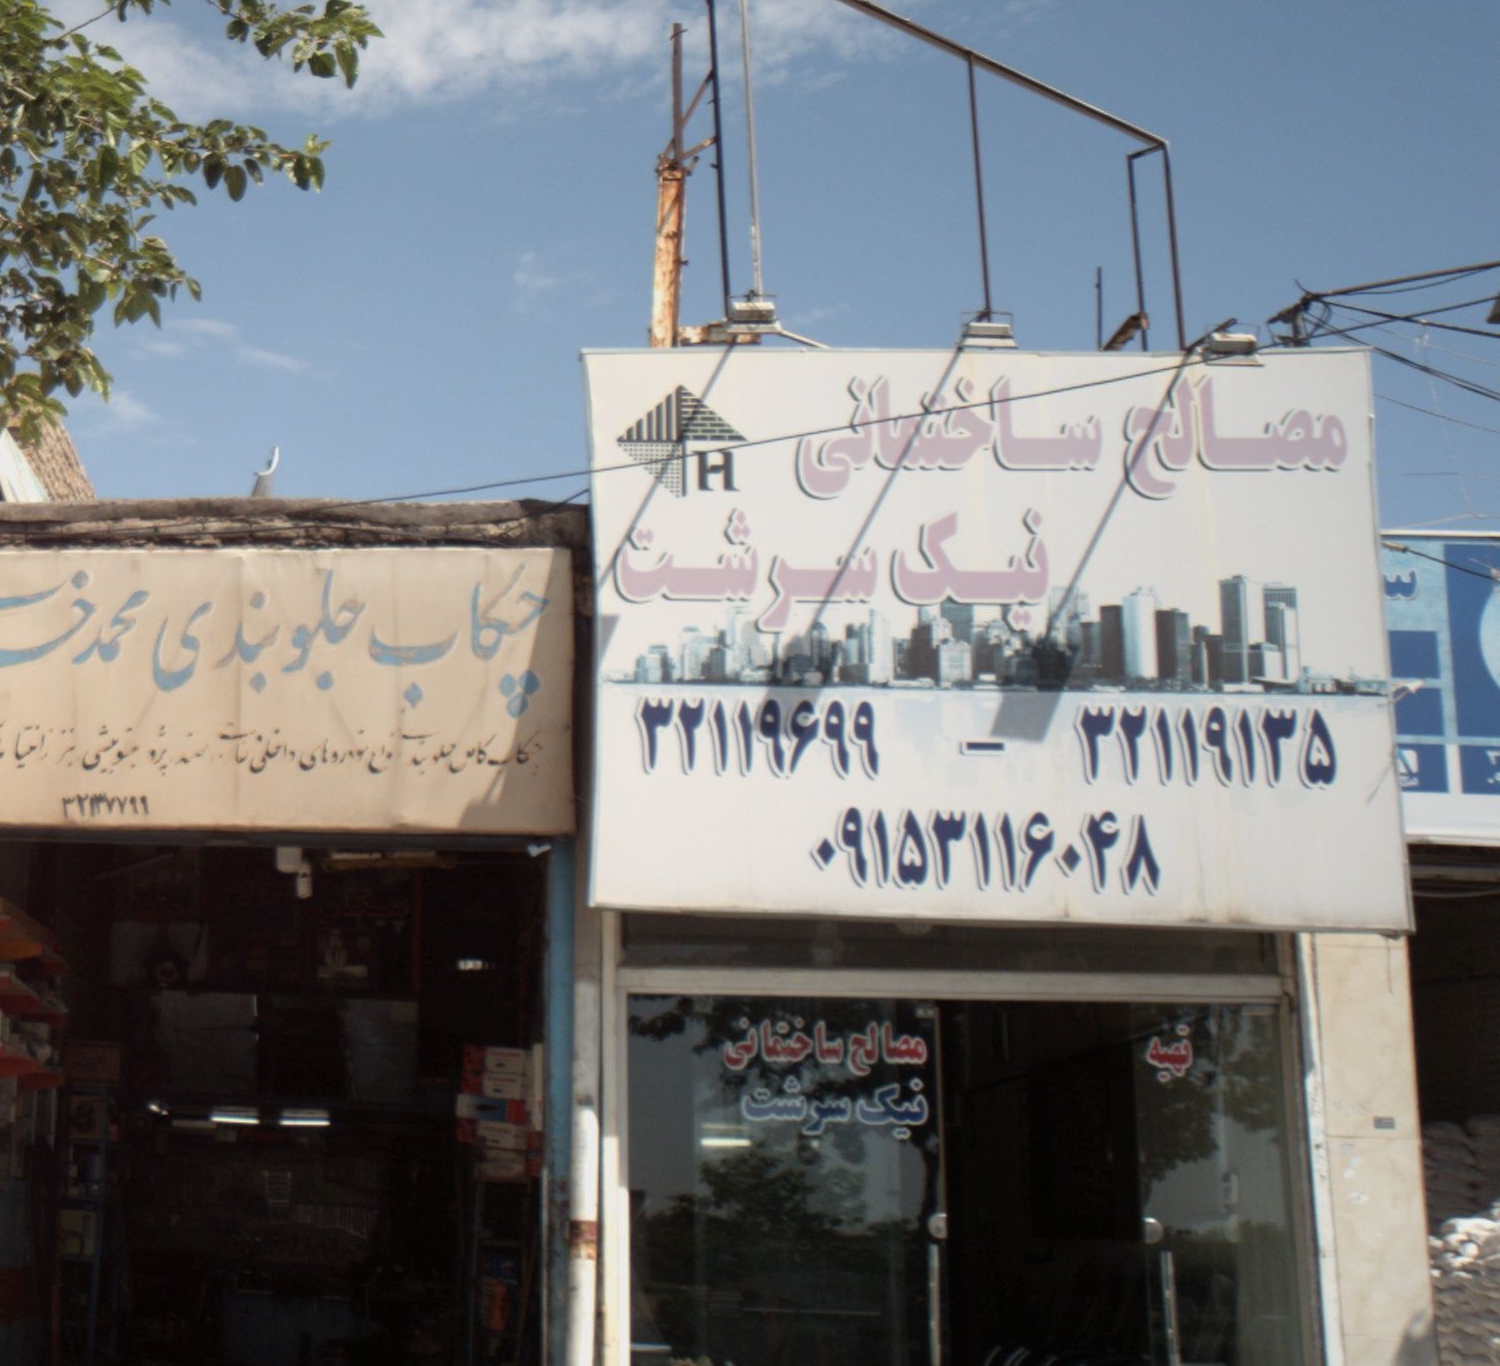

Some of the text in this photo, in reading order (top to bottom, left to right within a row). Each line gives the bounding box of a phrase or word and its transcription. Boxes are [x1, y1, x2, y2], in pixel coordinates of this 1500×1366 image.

[794, 375, 1348, 501] مصالح ساختمانی
[613, 507, 1049, 635] نیک سرشت
[71, 589, 150, 665] محمد
[152, 569, 367, 693] جلوبندی
[368, 561, 551, 720] چکاب
[636, 696, 880, 780] ۳۲۱۱۹۶۹۹
[1075, 703, 1338, 790] ۳۲۱۱۹۱۳۵
[810, 805, 1162, 896] ۰۹۱۵۳۱۱۶۰۴۸
[724, 1017, 928, 1076] مصالح ساختمانی
[741, 1075, 929, 1140] نیک سرشت
